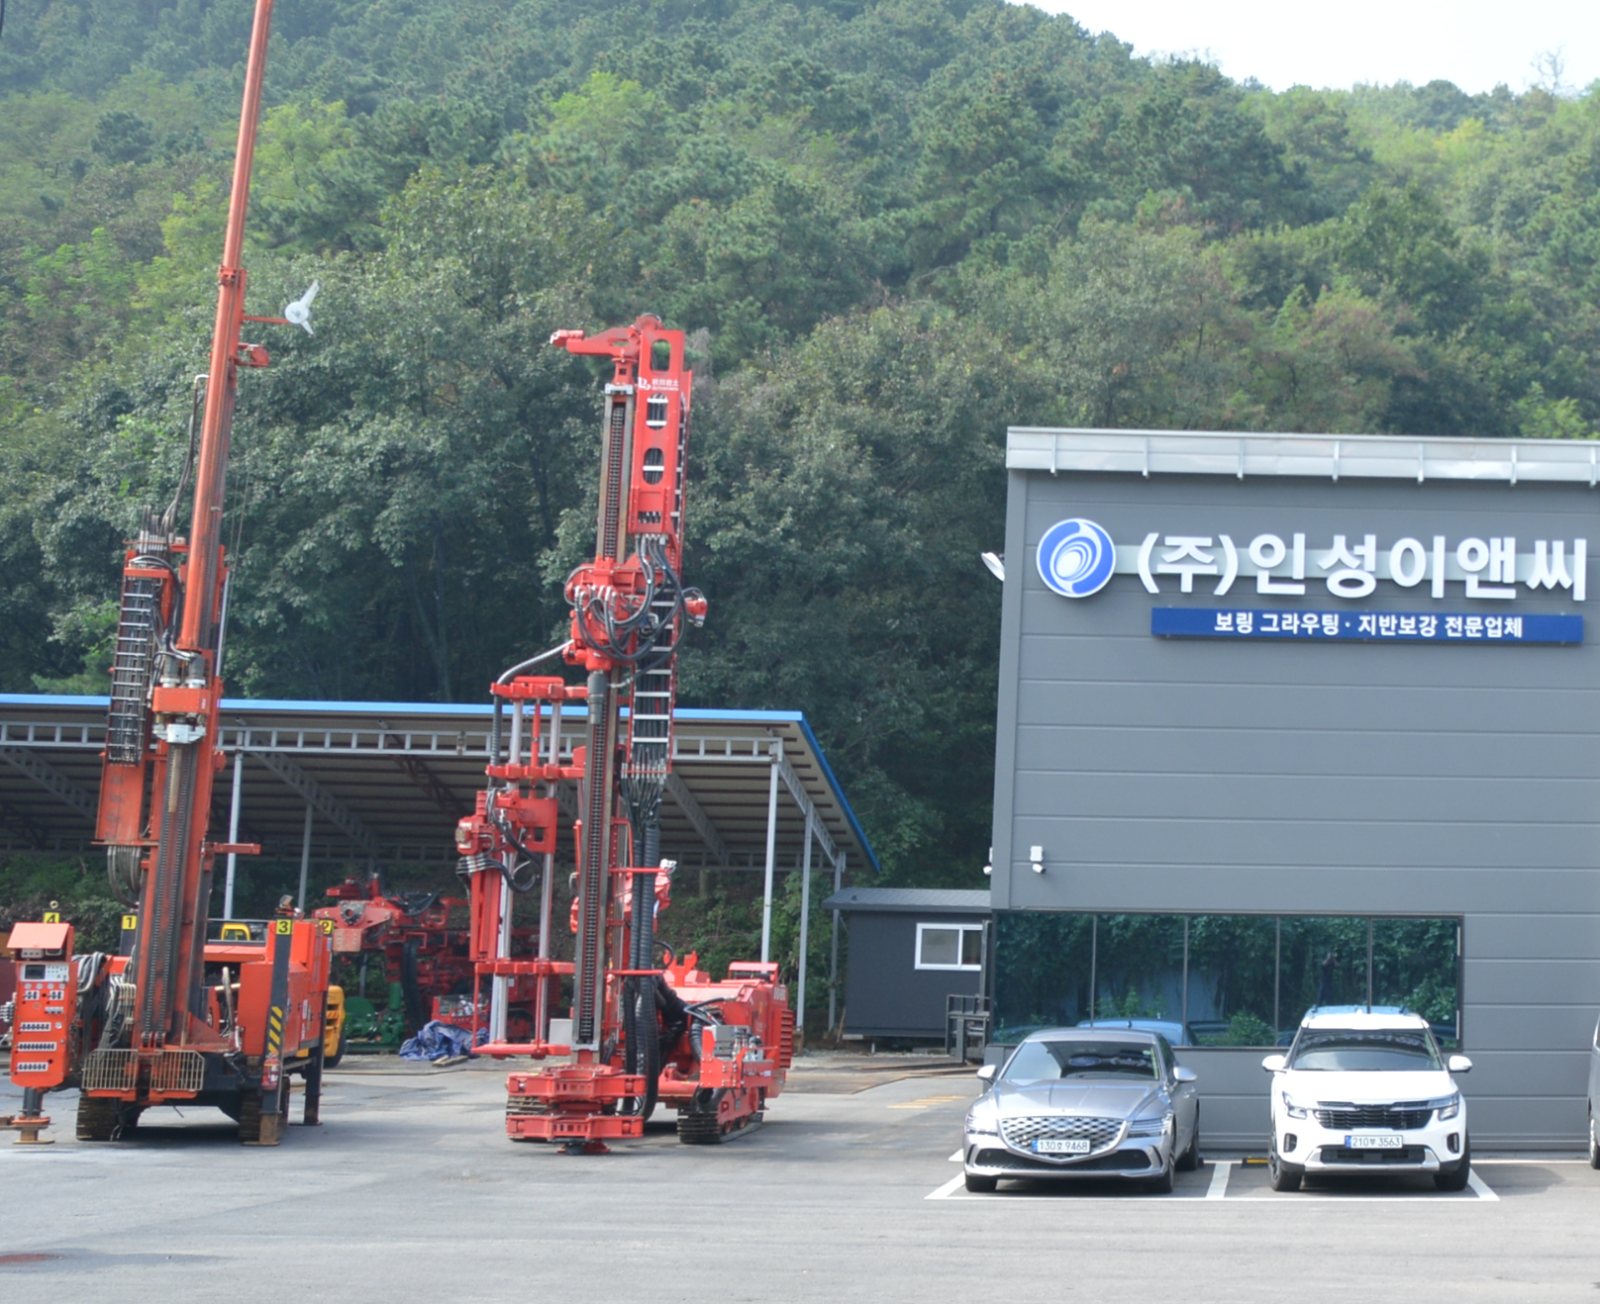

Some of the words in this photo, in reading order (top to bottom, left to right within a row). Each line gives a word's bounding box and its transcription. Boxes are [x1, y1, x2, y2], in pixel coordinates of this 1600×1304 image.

[1137, 532, 1587, 600] (주)인성이앤씨
[1214, 612, 1253, 633] 보링
[1260, 613, 1339, 634] 그라우팅
[1358, 614, 1437, 636] 지반보강
[1444, 616, 1523, 638] 전문업체
[126, 917, 133, 928] 1
[278, 921, 289, 933] 3
[1065, 1141, 1088, 1151] 9468
[1378, 1137, 1400, 1147] 3563
